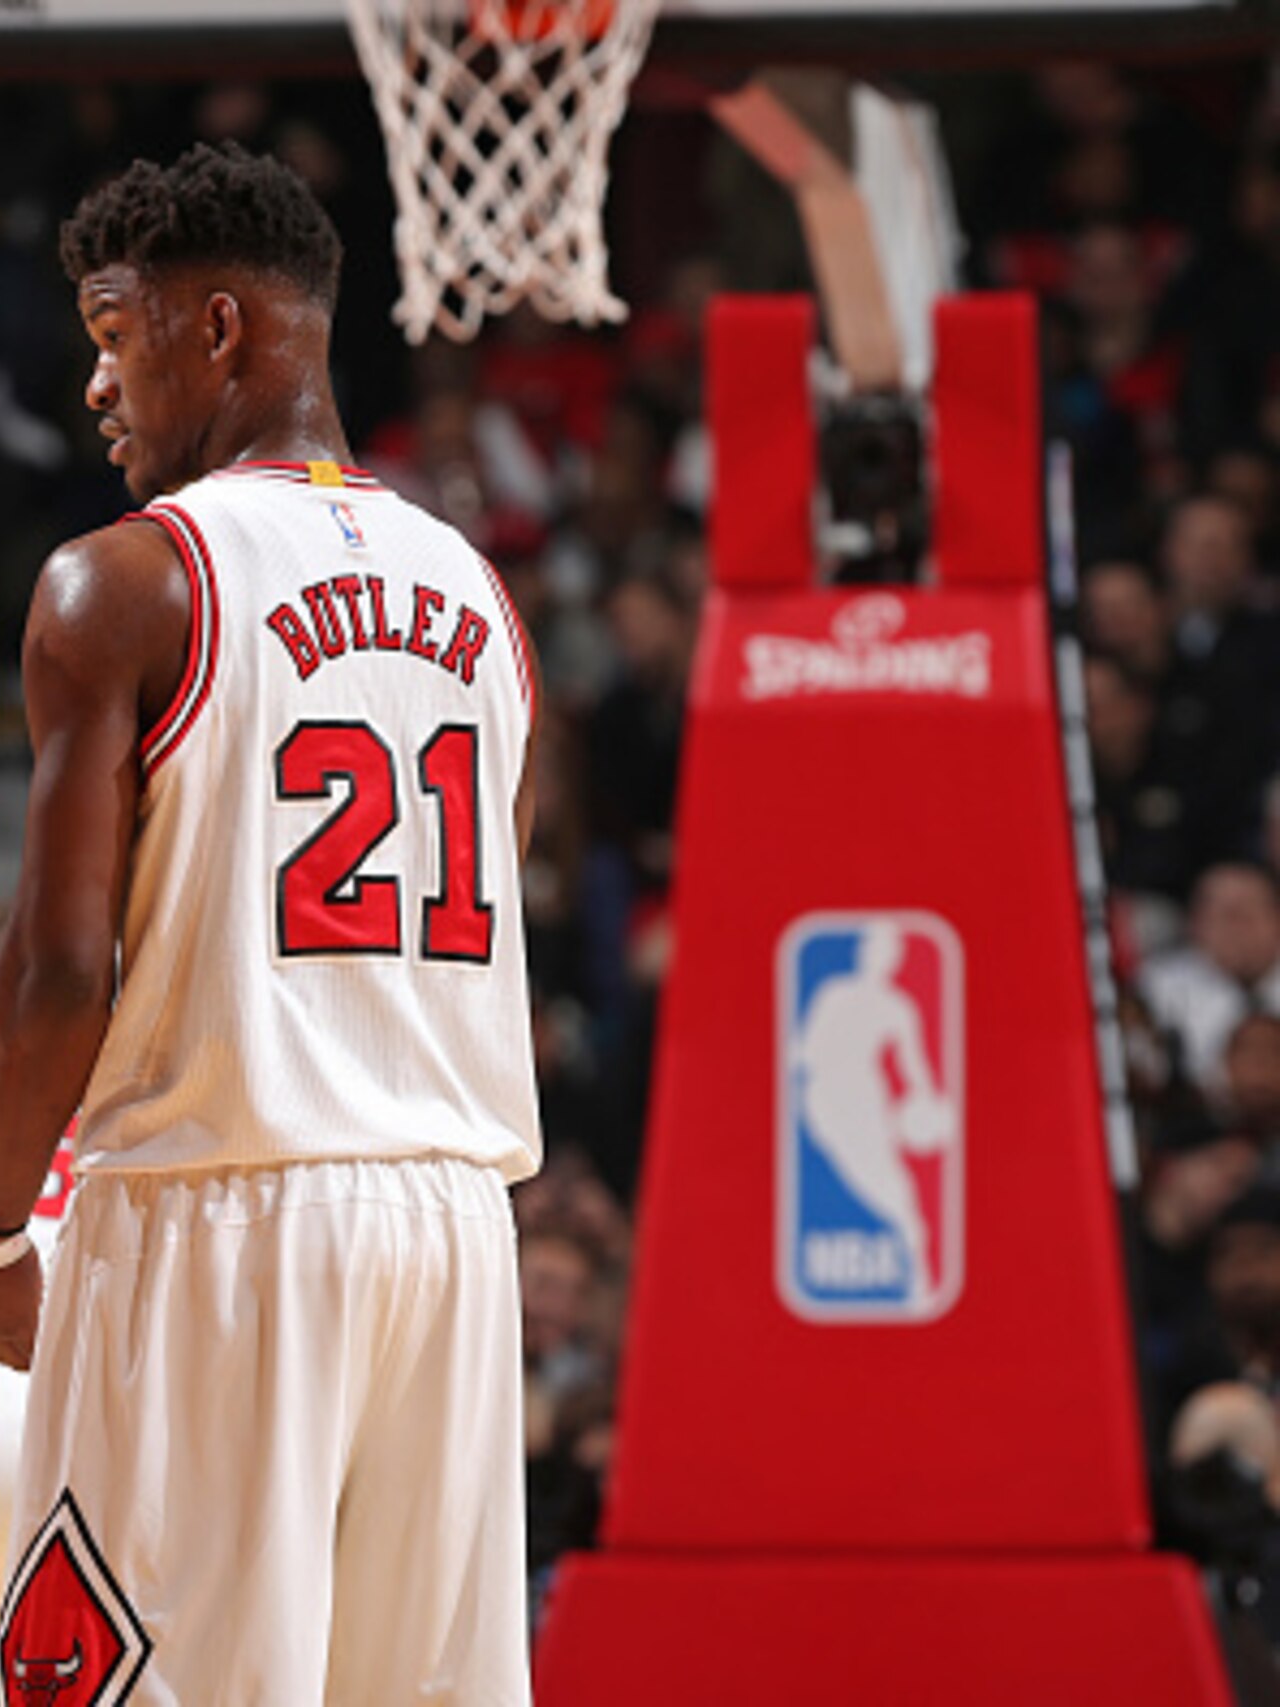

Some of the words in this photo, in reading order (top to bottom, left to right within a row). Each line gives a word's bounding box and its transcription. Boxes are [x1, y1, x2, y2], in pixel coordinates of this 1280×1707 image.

[265, 574, 491, 686] BUTLER
[741, 632, 991, 701] SPALDING
[275, 719, 494, 965] 21
[805, 1230, 899, 1287] NBA
